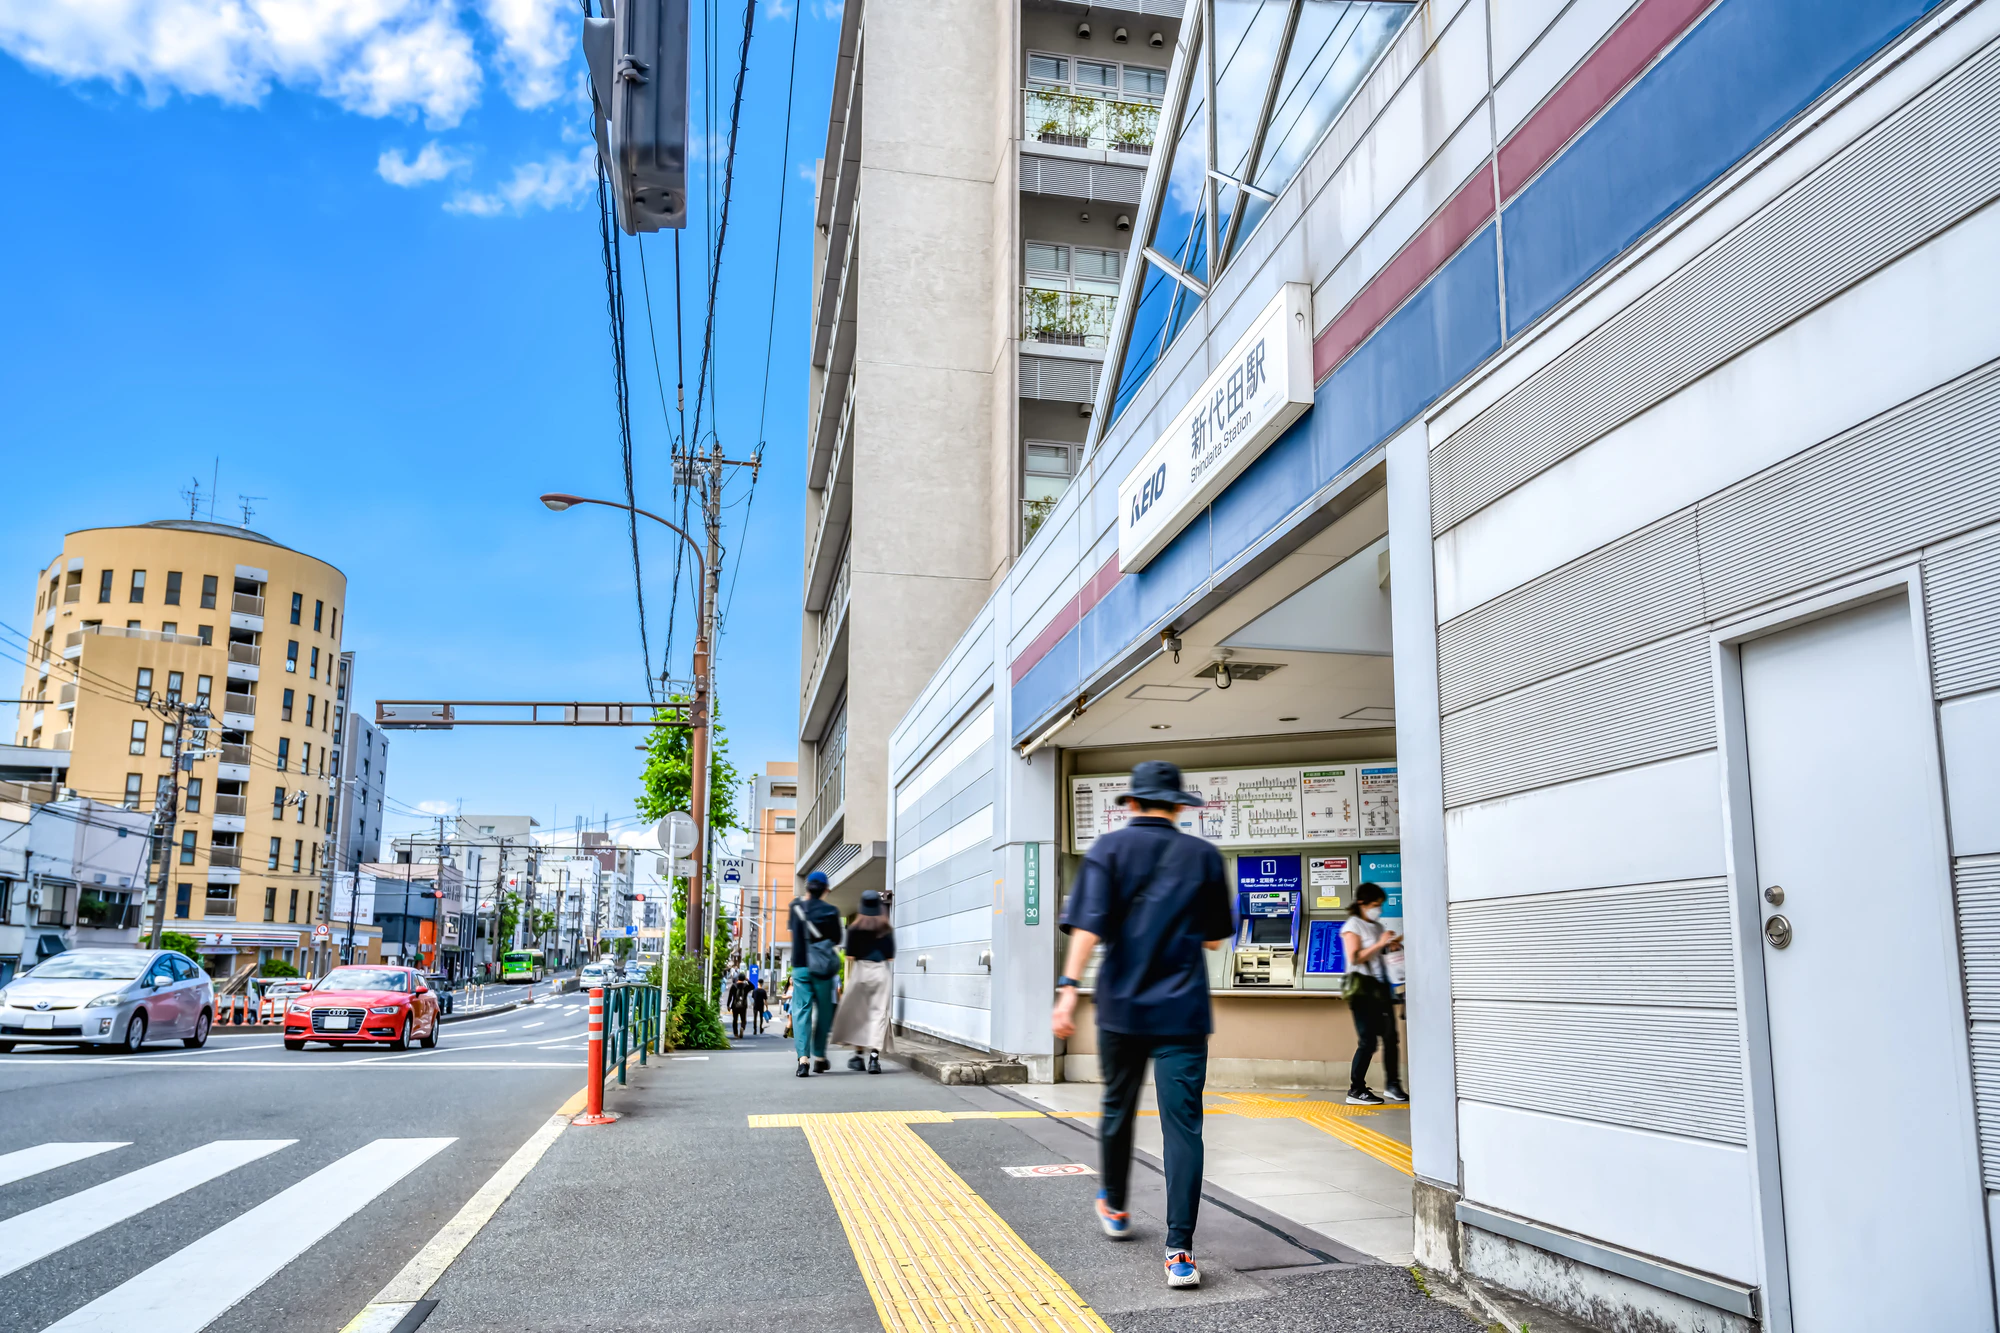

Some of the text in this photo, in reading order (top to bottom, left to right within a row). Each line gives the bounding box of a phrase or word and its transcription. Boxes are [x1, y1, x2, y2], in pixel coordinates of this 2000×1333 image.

[1191, 337, 1266, 460] 新代田駅
[1190, 410, 1252, 483] Shindaita Station
[1130, 462, 1167, 529] KEIO
[721, 859, 744, 867] TAXI
[1026, 908, 1038, 917] 30
